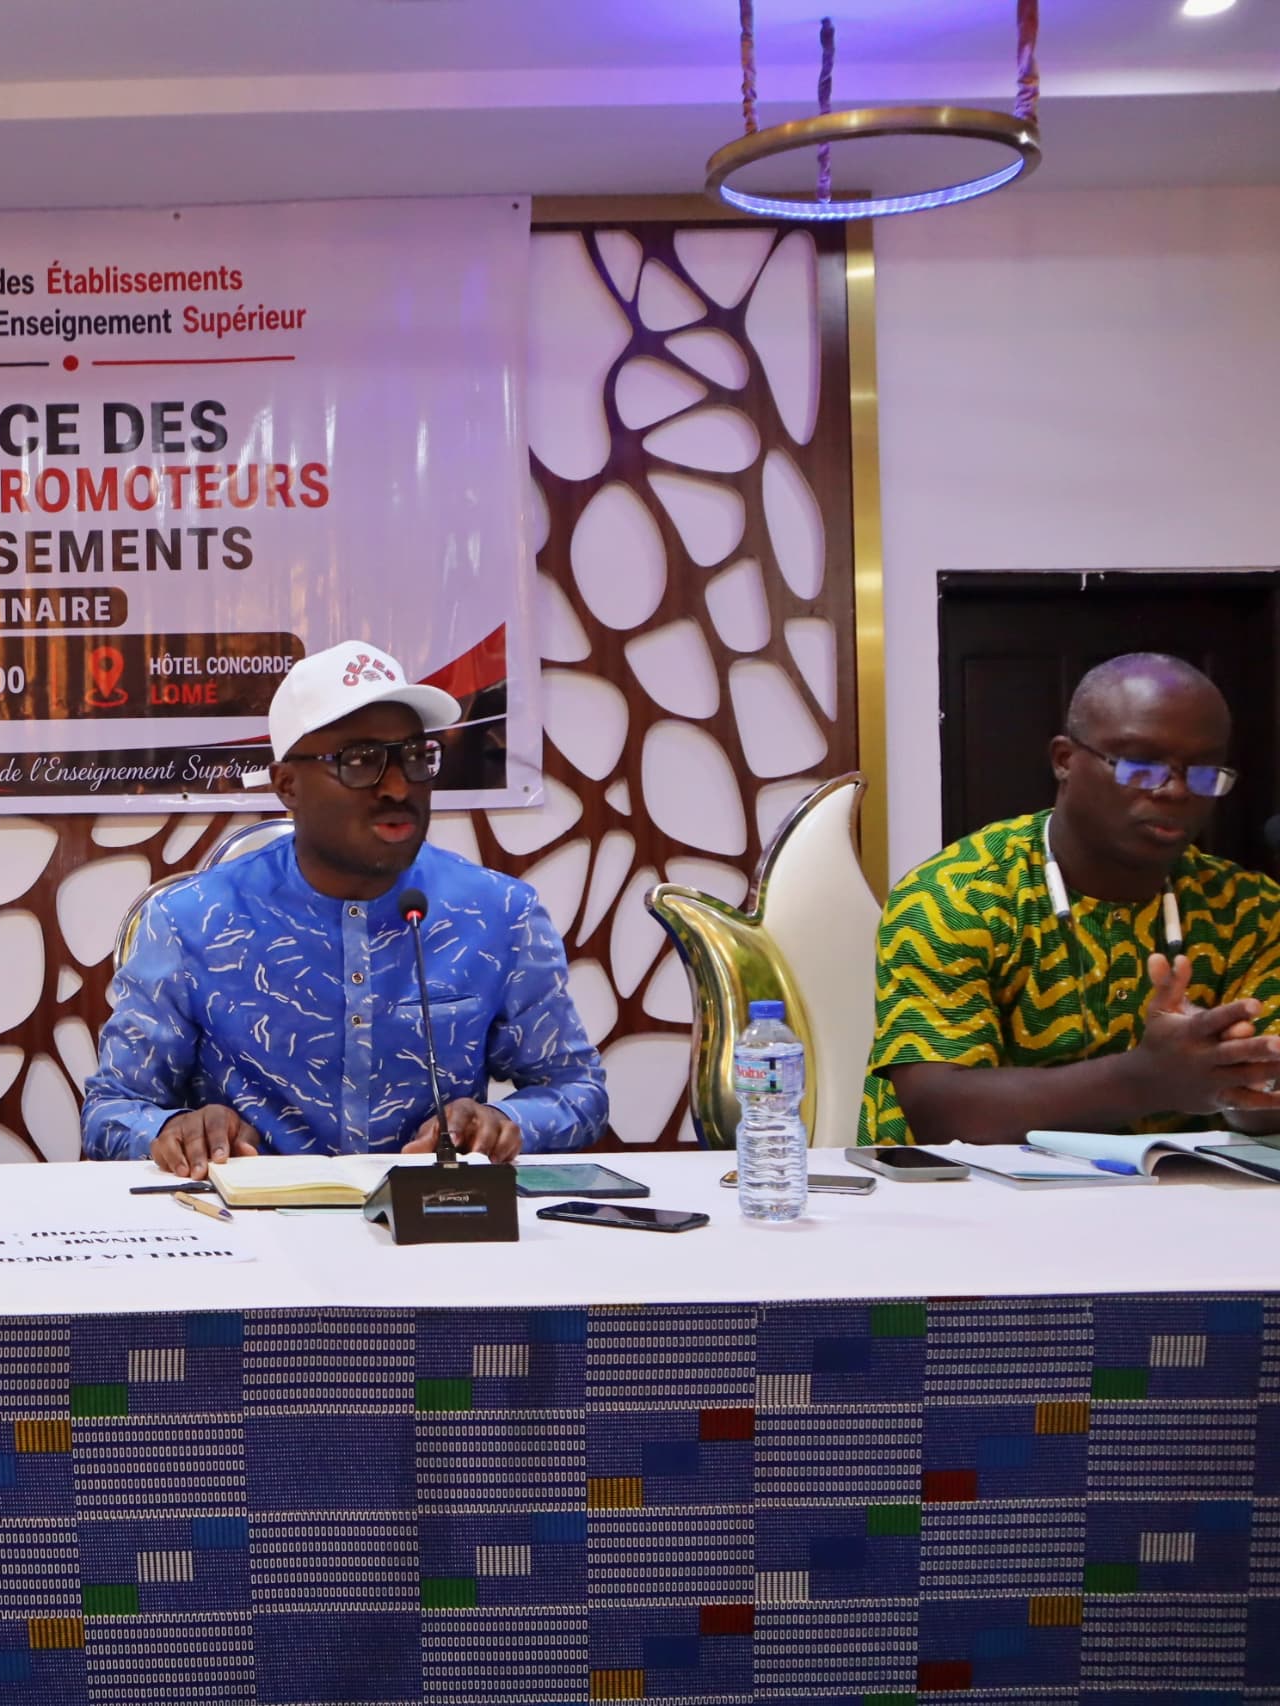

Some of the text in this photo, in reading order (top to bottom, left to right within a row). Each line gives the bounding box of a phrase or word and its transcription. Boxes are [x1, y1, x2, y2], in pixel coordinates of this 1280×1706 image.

[46, 260, 243, 295] Établissements
[182, 304, 306, 338] Supérieur
[103, 399, 228, 454] DES
[149, 653, 293, 675] HÔTEL CONCORDE
[150, 679, 218, 704] LOMÉ
